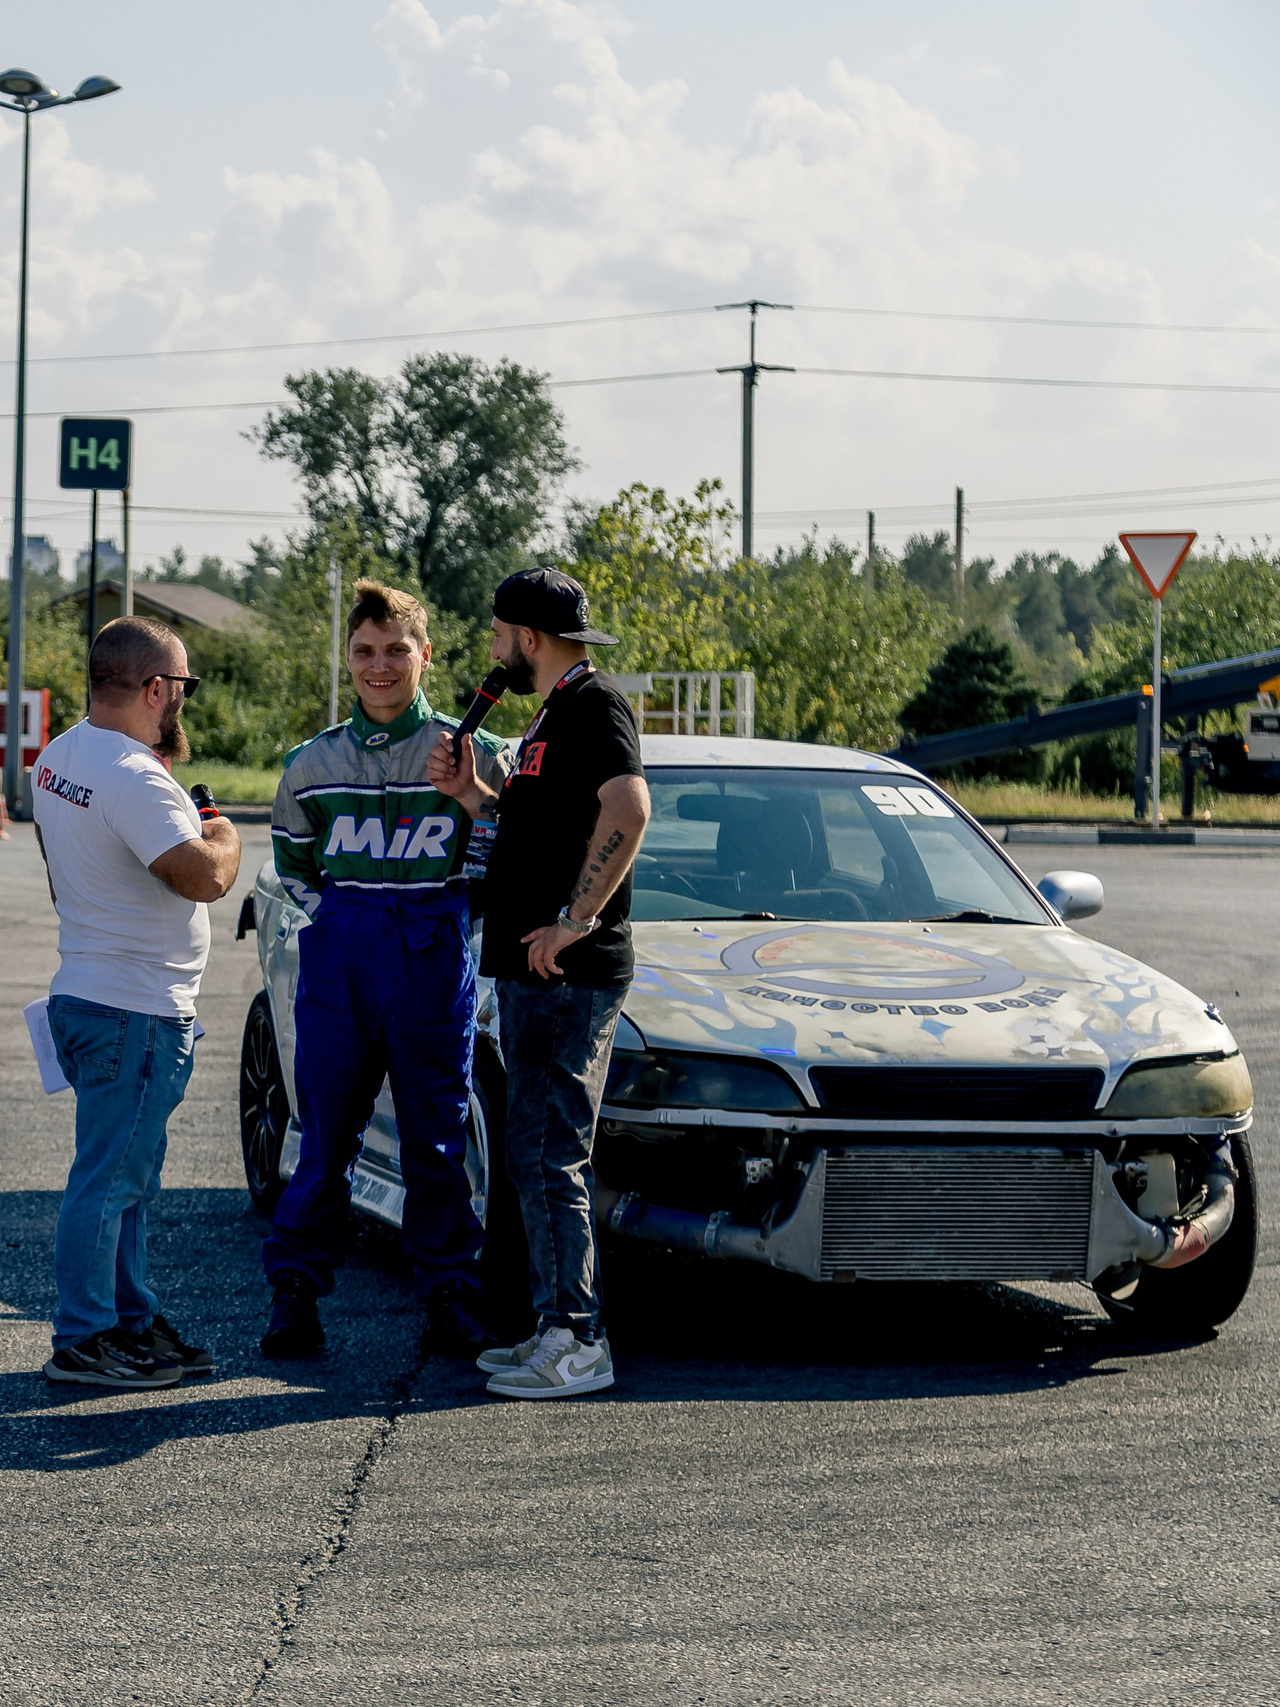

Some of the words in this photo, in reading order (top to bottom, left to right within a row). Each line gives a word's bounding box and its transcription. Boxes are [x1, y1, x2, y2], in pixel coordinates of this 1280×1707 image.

[69, 437, 121, 471] H4
[860, 785, 956, 818] 90
[323, 814, 455, 859] MiR
